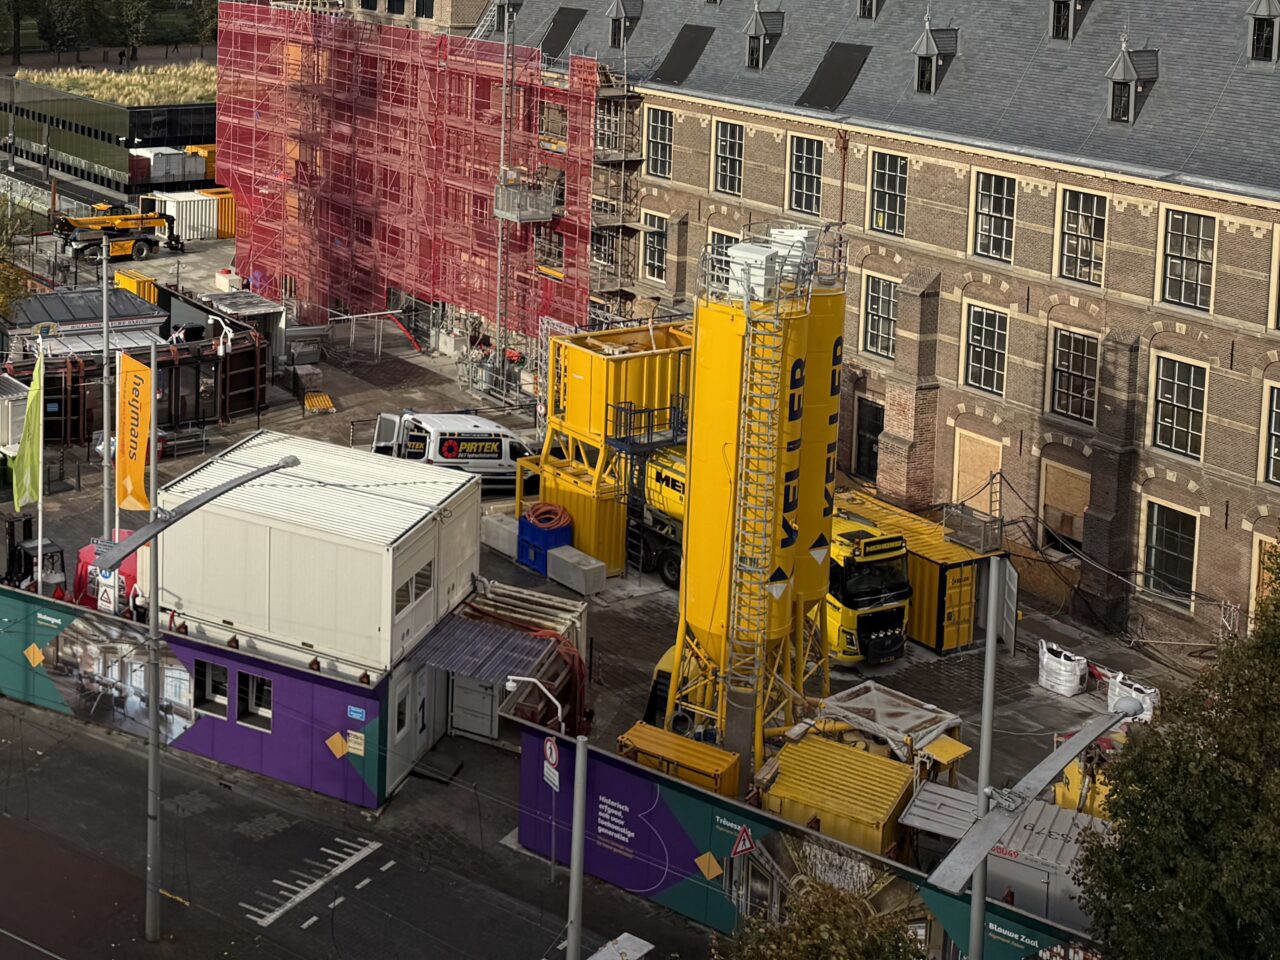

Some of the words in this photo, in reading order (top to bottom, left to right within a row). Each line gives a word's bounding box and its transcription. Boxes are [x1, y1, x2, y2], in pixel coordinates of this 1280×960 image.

[458, 441, 499, 453] PIRTEK
[419, 696, 426, 734] 1
[599, 795, 629, 812] Historisch
[598, 826, 629, 843] generaties
[988, 922, 1019, 940] Blauwe
[1020, 934, 1039, 948] Zaal
